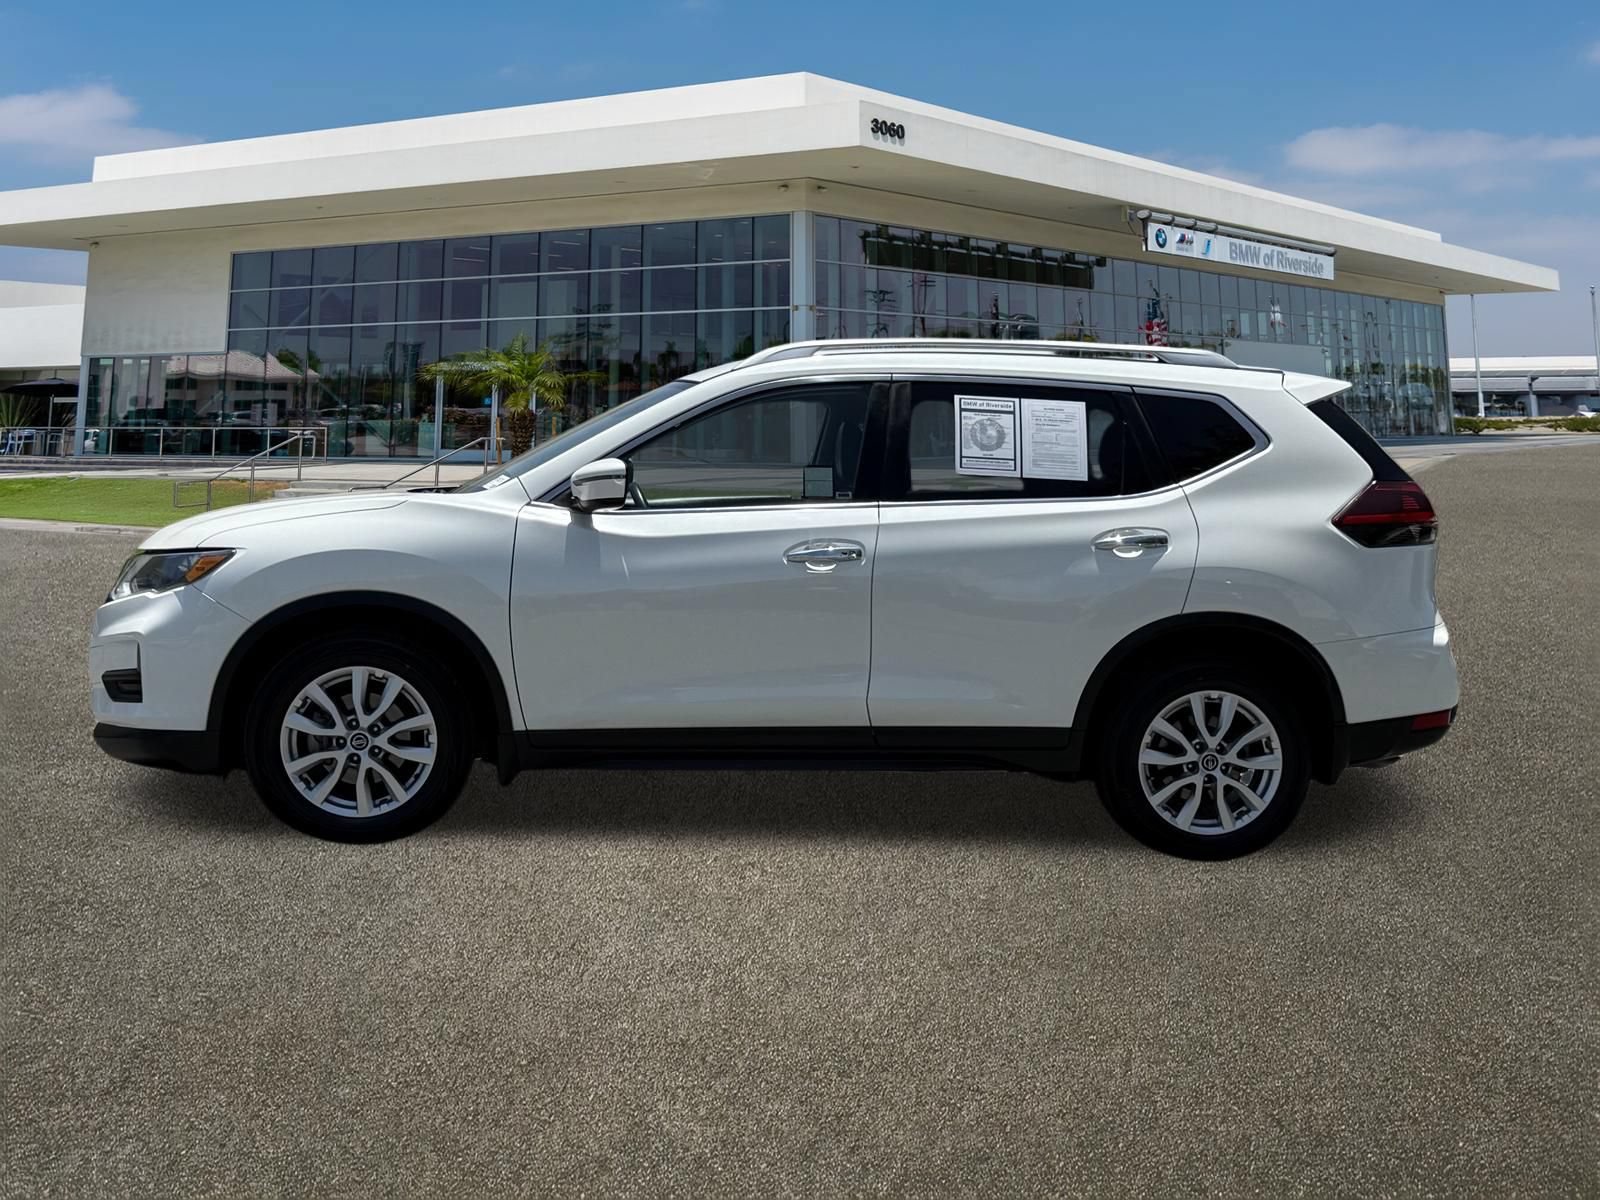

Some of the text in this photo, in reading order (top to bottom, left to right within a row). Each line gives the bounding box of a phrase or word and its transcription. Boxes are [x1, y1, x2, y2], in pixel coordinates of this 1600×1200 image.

[870, 118, 905, 139] 3060
[1229, 241, 1261, 265] BMW
[1262, 249, 1275, 267] of
[1276, 250, 1324, 275] Riverside
